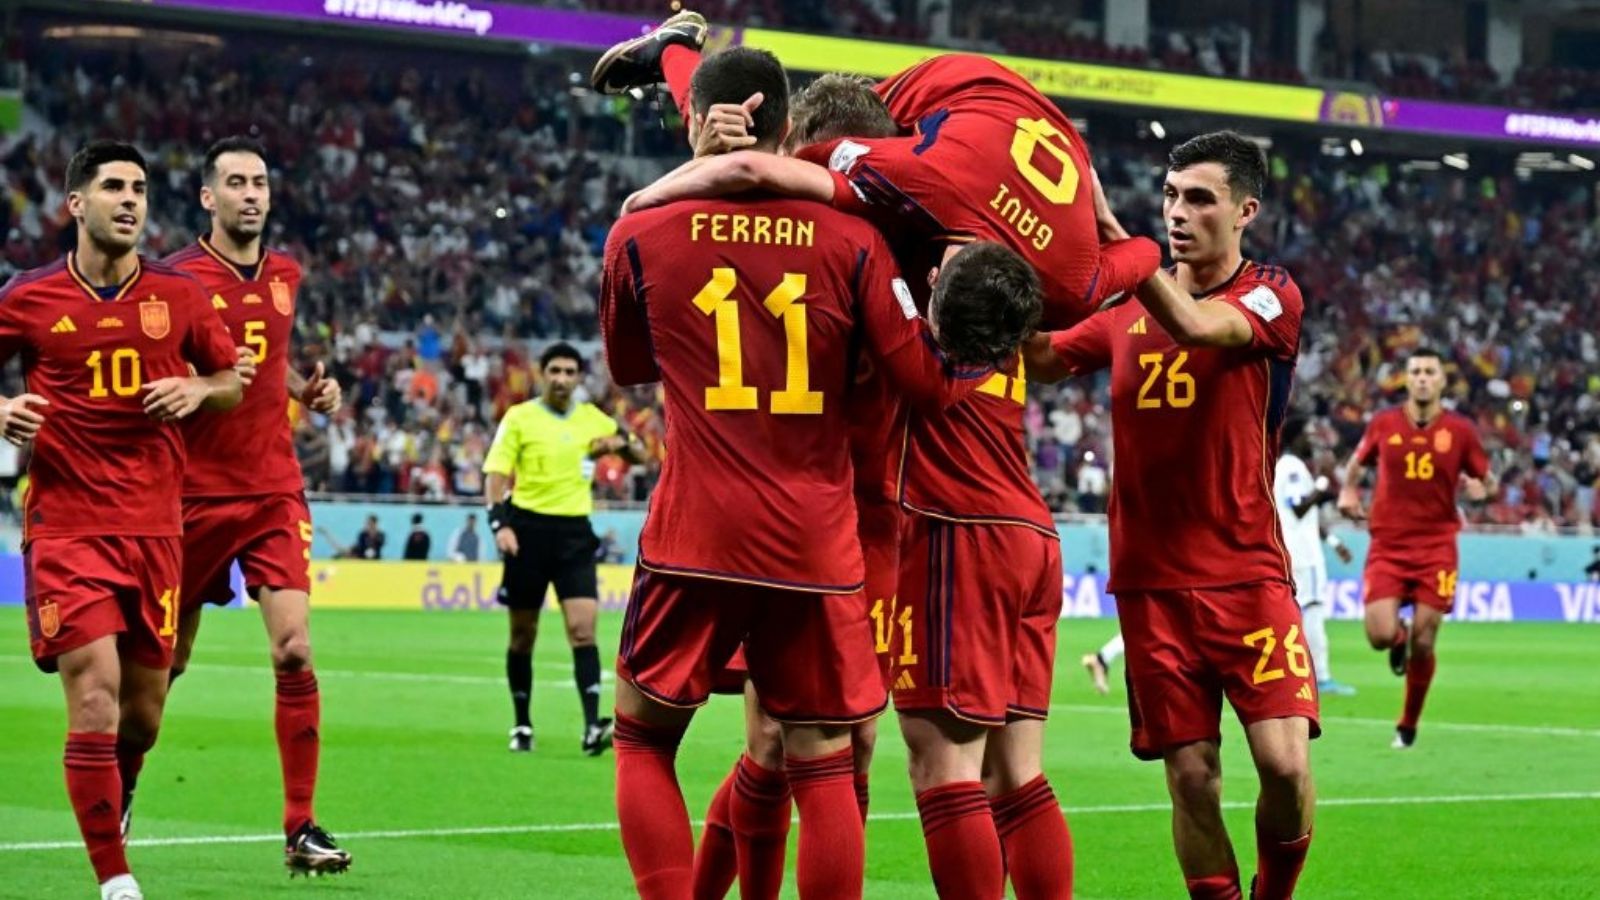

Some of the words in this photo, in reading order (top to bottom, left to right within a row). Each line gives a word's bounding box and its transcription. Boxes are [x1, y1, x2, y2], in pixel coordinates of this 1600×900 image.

[691, 213, 815, 248] FERRAN
[245, 321, 267, 364] 5
[692, 267, 824, 415] 11
[86, 348, 141, 398] 10
[1136, 351, 1196, 410] 26
[1405, 451, 1434, 480] 16
[1062, 575, 1102, 617] SA
[1322, 580, 1365, 619] IS
[1456, 581, 1514, 621] ISA
[1552, 582, 1600, 622] VI
[1242, 624, 1311, 686] 26
